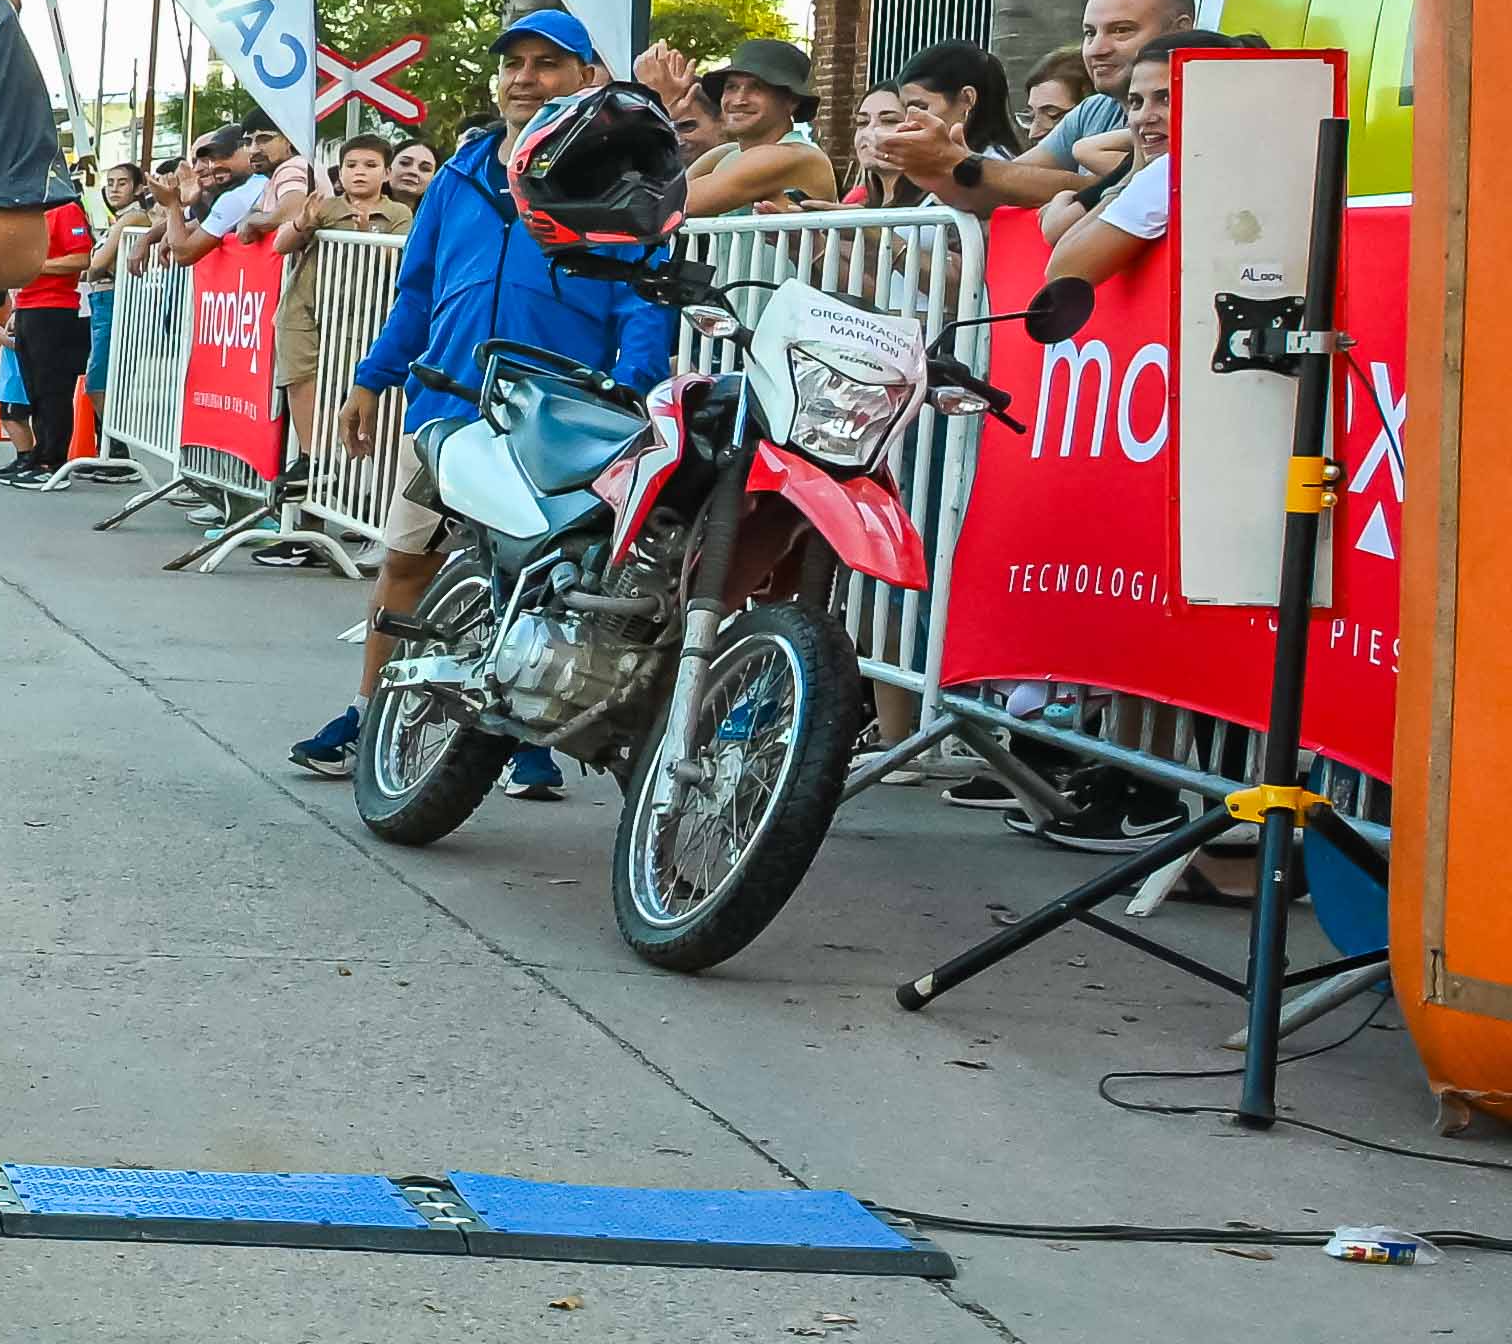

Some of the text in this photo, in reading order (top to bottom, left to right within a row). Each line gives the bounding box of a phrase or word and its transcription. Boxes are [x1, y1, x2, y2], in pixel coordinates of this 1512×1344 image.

[198, 268, 265, 368] moplex
[830, 324, 899, 358] MARATON
[839, 354, 884, 372] HONDA
[1007, 564, 1168, 605] TECNOLOGI
